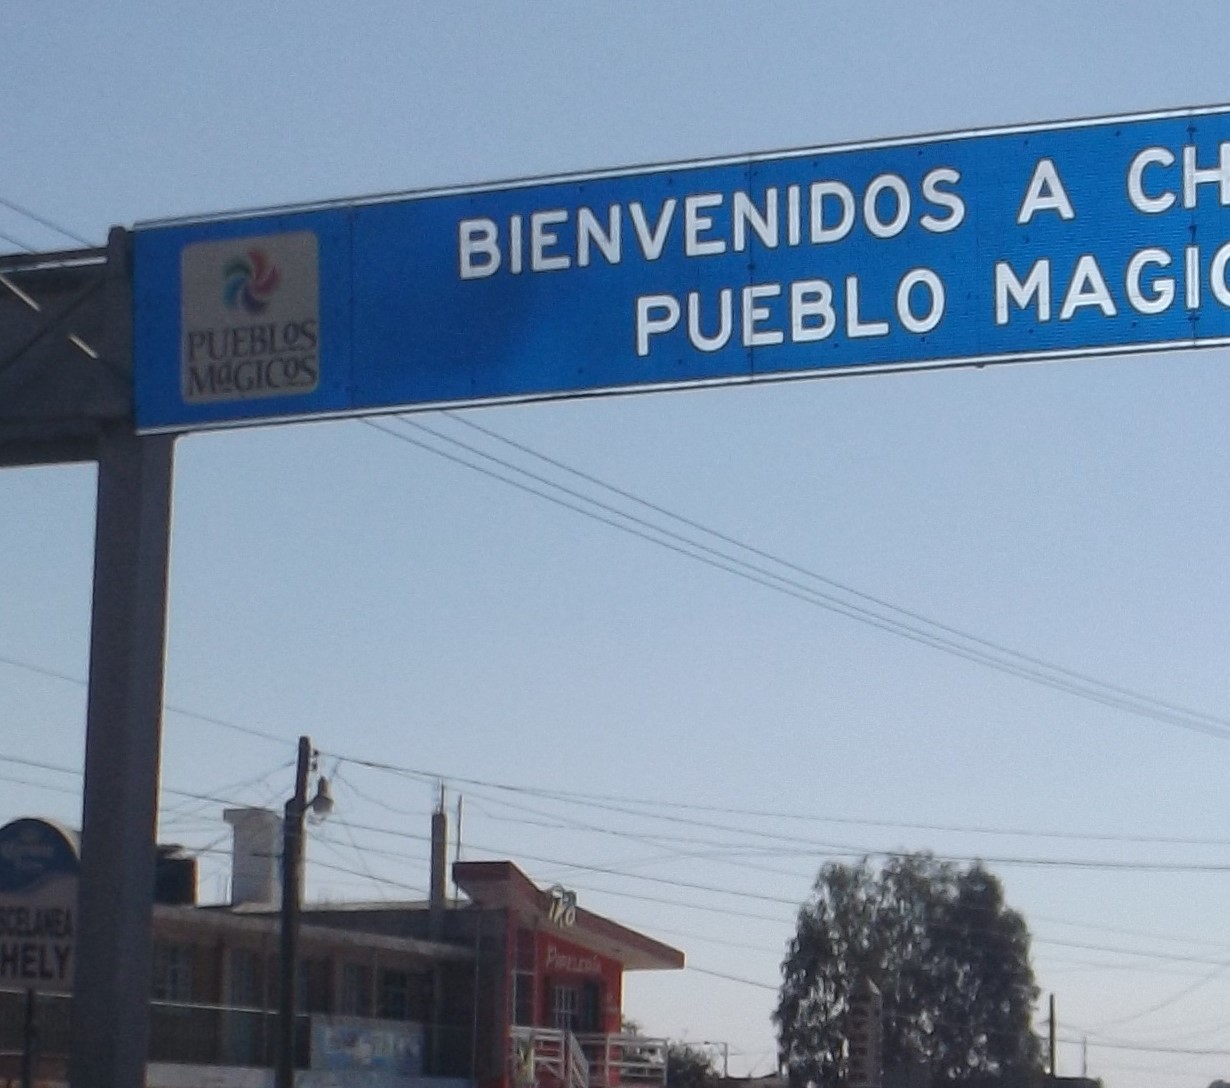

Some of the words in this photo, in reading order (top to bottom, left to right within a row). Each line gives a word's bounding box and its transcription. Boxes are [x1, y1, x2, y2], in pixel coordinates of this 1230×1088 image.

[458, 168, 966, 279] BIENVENIDOS
[1017, 158, 1076, 224] A
[636, 268, 946, 357] PUEBLO
